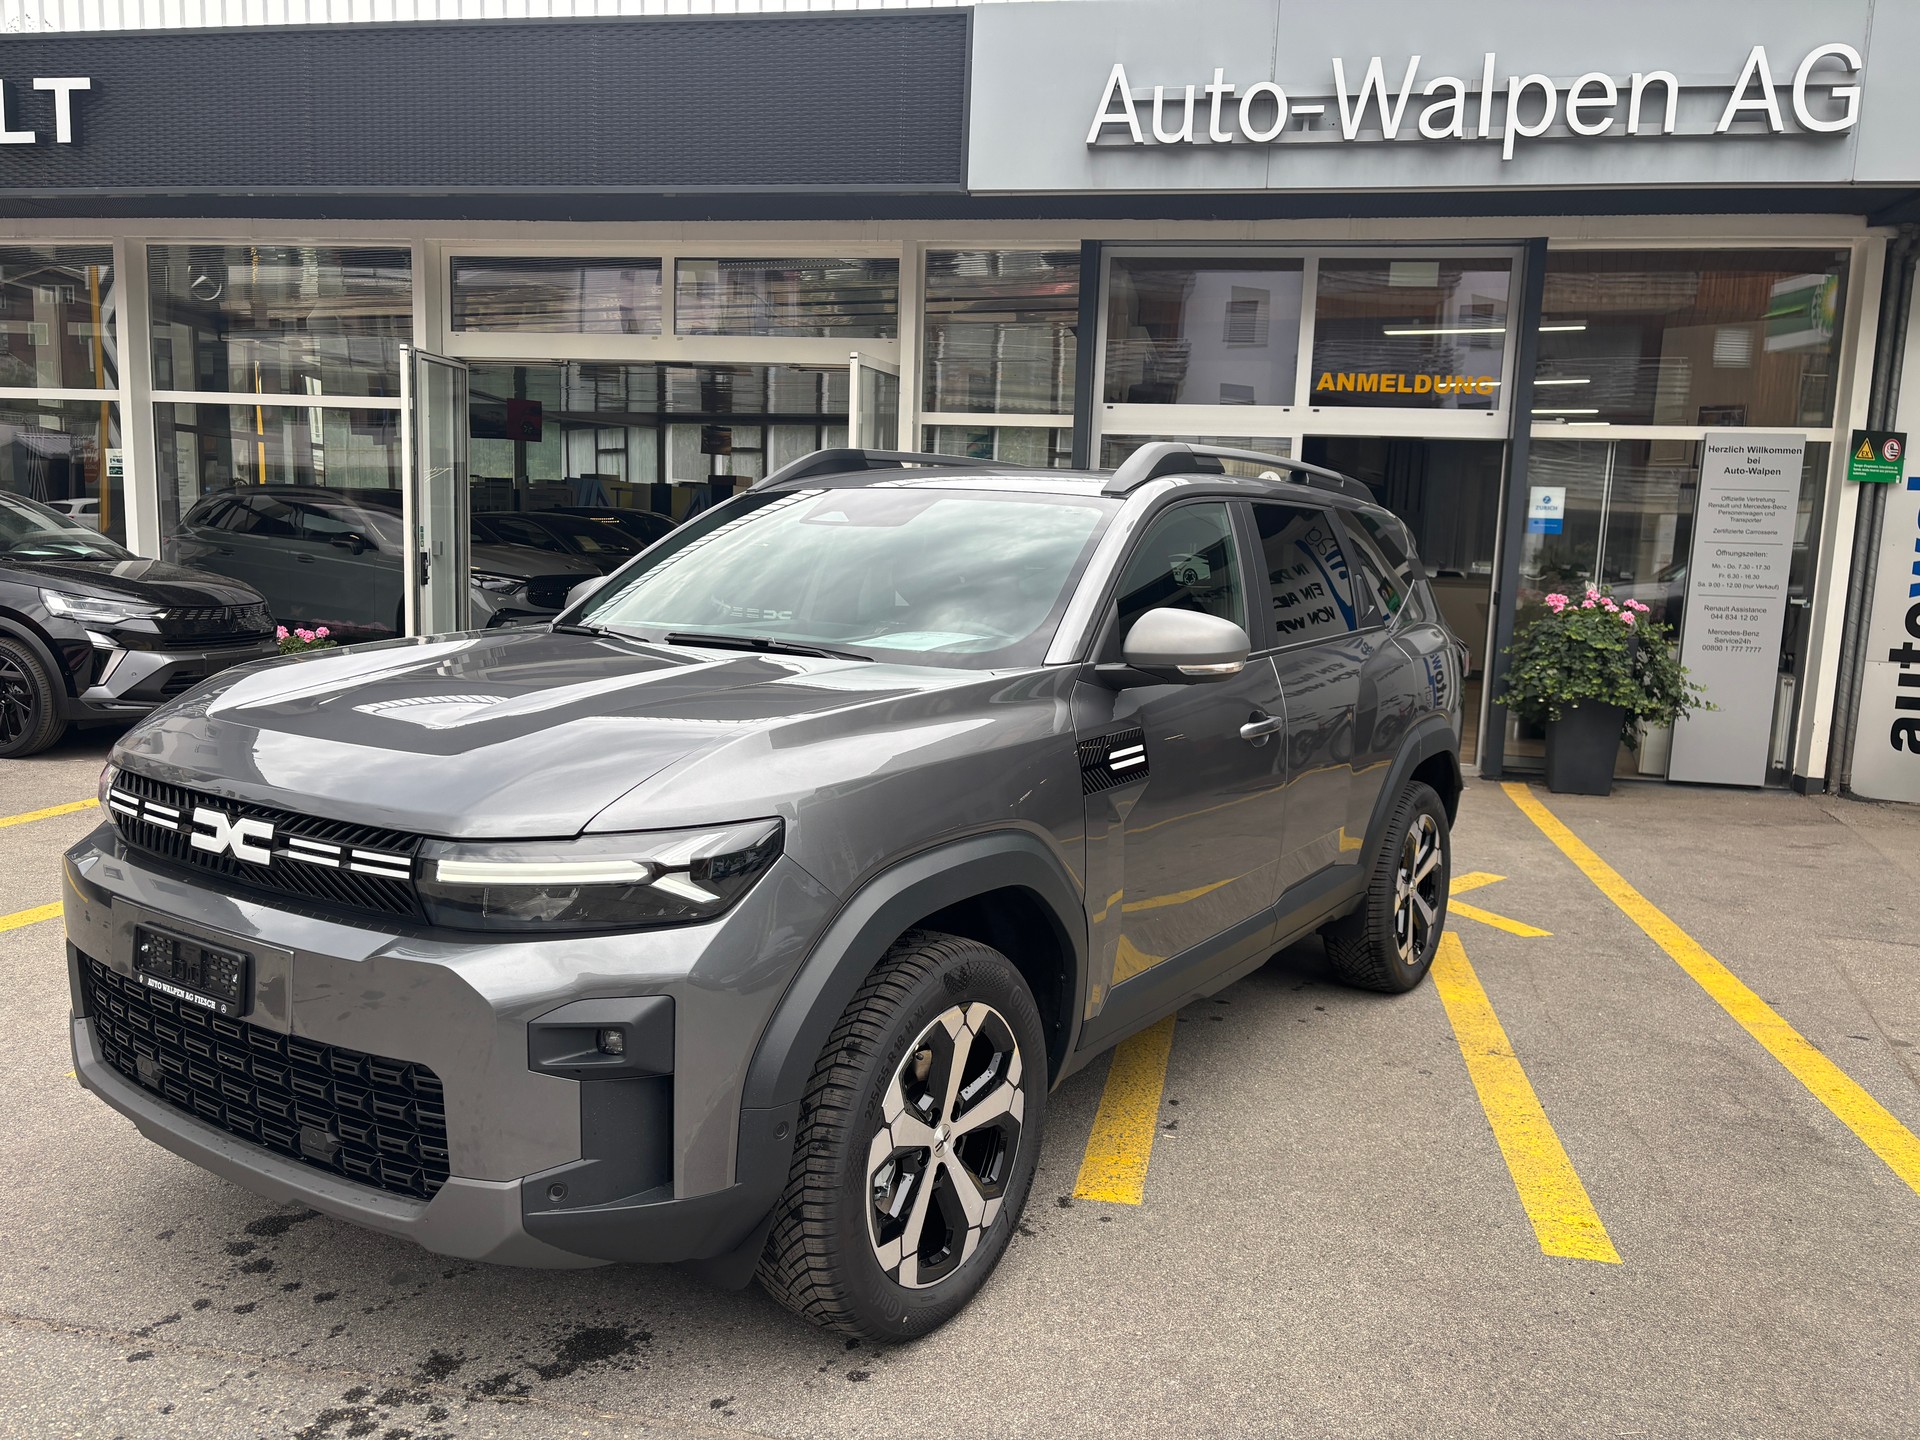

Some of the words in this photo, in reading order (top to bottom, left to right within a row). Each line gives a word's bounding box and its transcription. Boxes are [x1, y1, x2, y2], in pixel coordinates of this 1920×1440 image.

[1086, 52, 1679, 160] Auto-Walpen
[1717, 43, 1862, 135] AG
[1316, 372, 1495, 395] ANMELDUNG
[1708, 445, 1745, 454] Herzlich
[1747, 446, 1802, 455] Willkommen
[1747, 456, 1761, 464] bei
[1723, 466, 1781, 476] Auto-Walpen
[1746, 496, 1776, 504] Vertretung
[1717, 509, 1763, 517] Personenwagen
[1703, 604, 1730, 612] Renault
[1731, 605, 1767, 614] Assistance
[1749, 614, 1759, 622] 00
[1707, 628, 1760, 637] Mercedes-Benz
[1714, 636, 1752, 645] Service24h
[147, 977, 162, 990] AUTO
[163, 982, 185, 998] WALPEN
[185, 991, 194, 1001] AG
[194, 995, 216, 1010] FIESCH
[887, 1051, 897, 1063] R
[893, 1034, 906, 1051] 18
